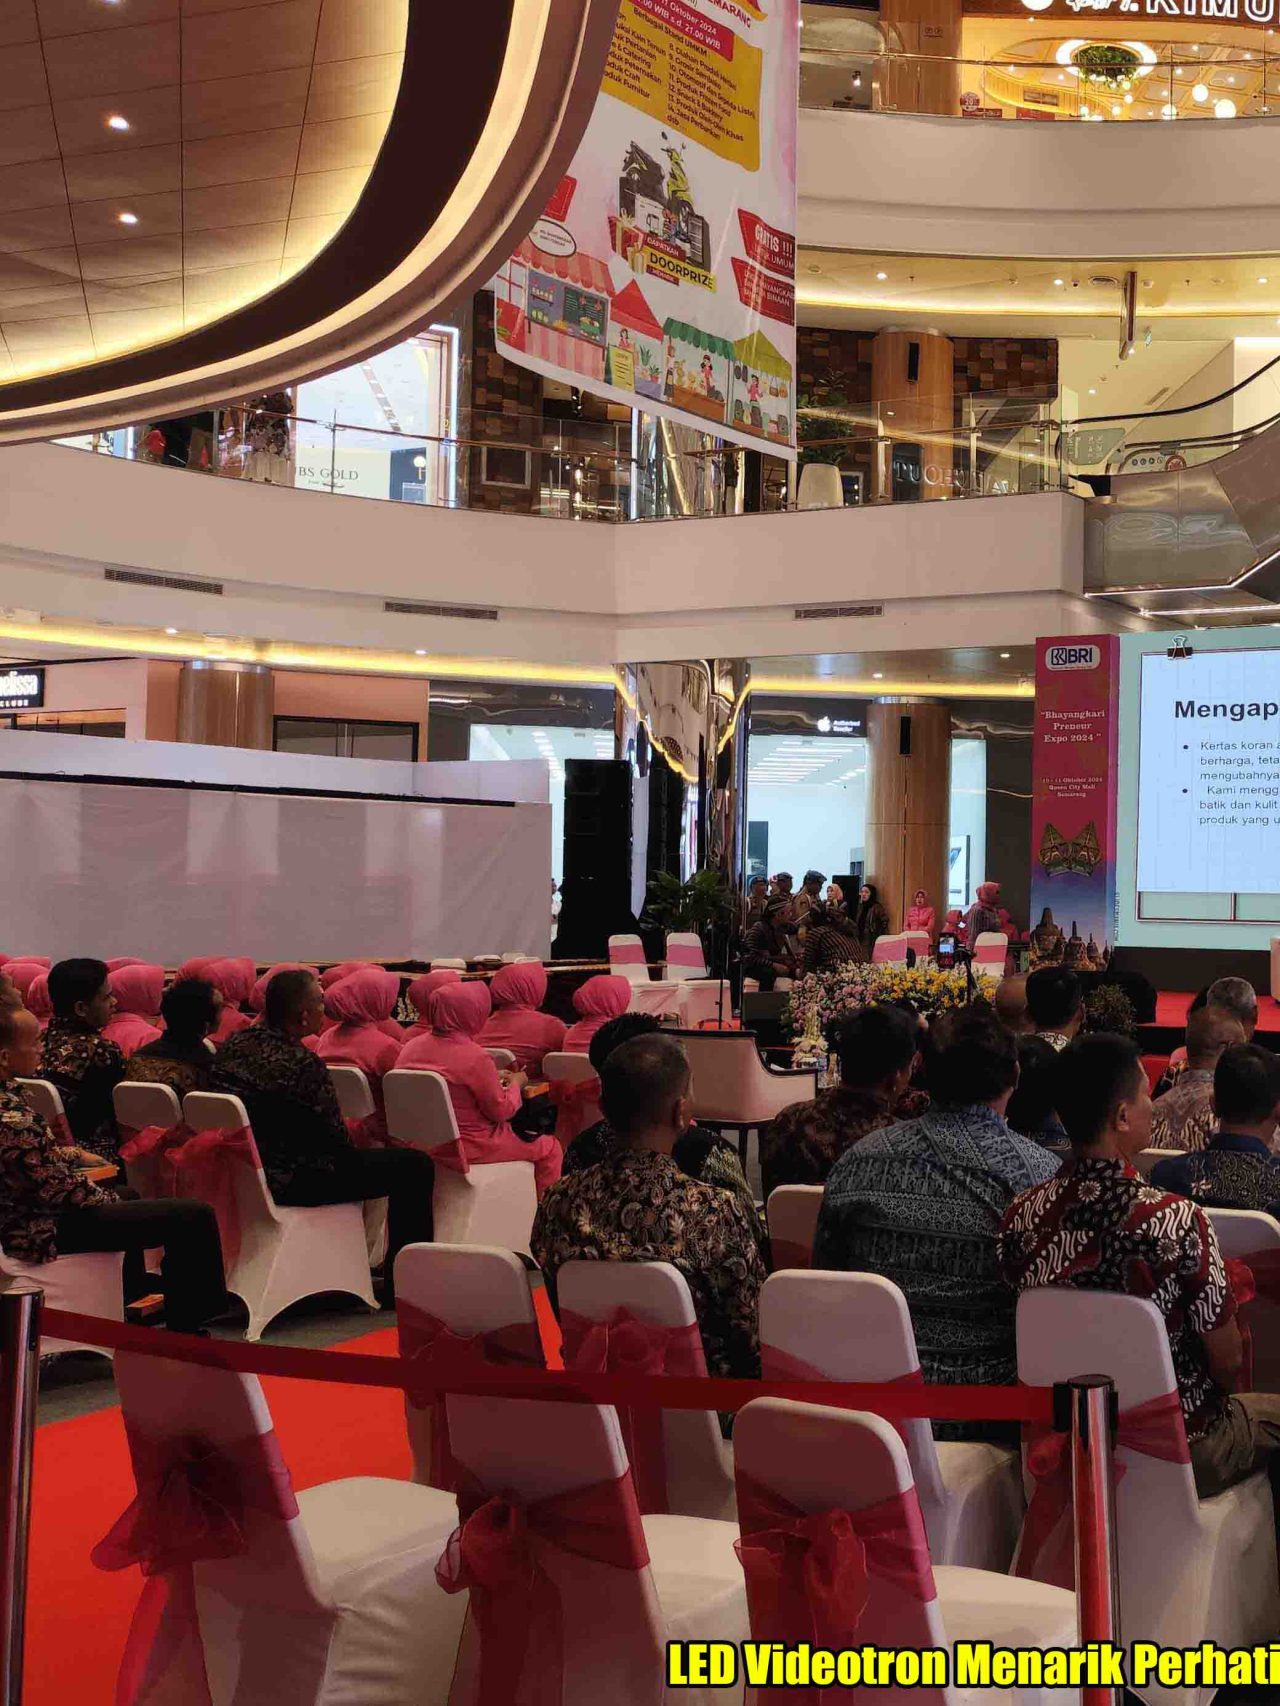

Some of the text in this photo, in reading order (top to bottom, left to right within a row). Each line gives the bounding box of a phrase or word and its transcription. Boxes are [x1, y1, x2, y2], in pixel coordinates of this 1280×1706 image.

[670, 0, 699, 23] Oktober
[699, 20, 717, 36] 2024
[654, 3, 670, 19] WIB
[685, 25, 704, 40] 21.00
[705, 36, 721, 49] WIB
[664, 26, 684, 43] Stand
[622, 46, 652, 69] Catering
[675, 47, 699, 66] Olahan
[623, 68, 641, 83] Craft
[623, 78, 651, 99] Furnitur
[676, 77, 698, 94] Produk
[725, 128, 744, 142] Khas
[755, 223, 780, 253] GRATIS
[650, 252, 713, 290] DOORPRIZE
[319, 467, 359, 481] GOLD
[1068, 647, 1093, 664] BRI
[1053, 722, 1093, 731] Preneur
[1044, 734, 1069, 744] Expo
[1070, 733, 1094, 743] 2024
[1200, 741, 1238, 751] Kertas
[1241, 741, 1274, 750] koran
[1200, 756, 1254, 767] berharga,
[1200, 770, 1280, 782] mengubahnya
[1207, 785, 1236, 795] Kami
[1199, 800, 1227, 810] batik
[1230, 800, 1251, 810] dan
[1255, 799, 1278, 809] kulit
[1199, 815, 1238, 826] produk
[1241, 816, 1269, 826] yang
